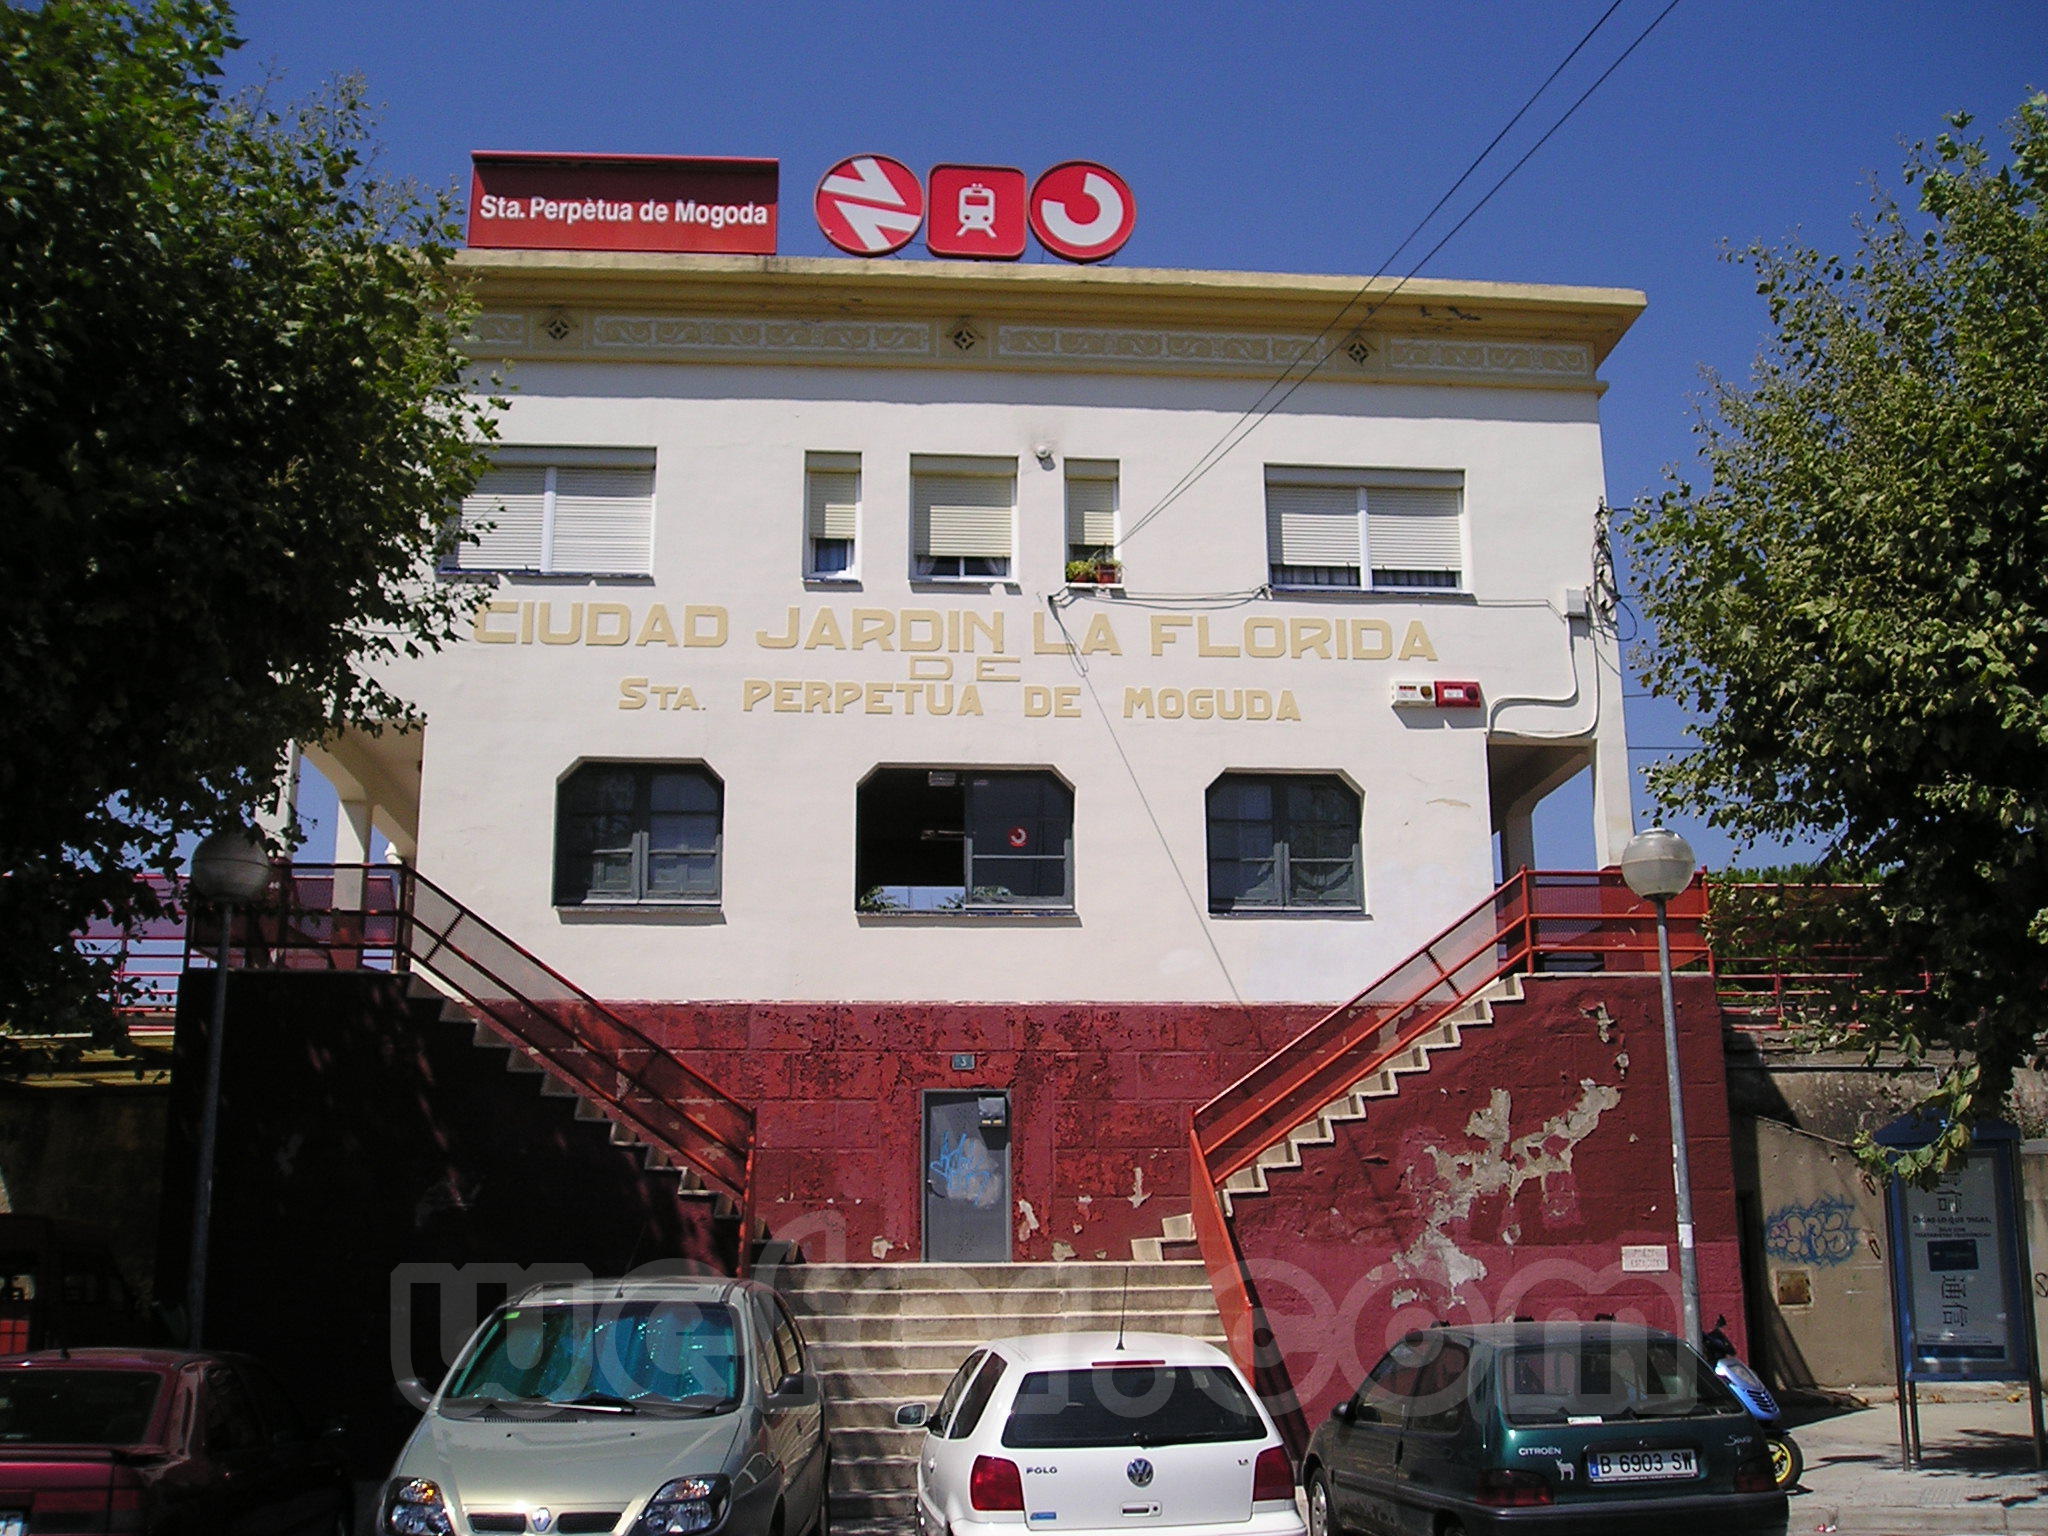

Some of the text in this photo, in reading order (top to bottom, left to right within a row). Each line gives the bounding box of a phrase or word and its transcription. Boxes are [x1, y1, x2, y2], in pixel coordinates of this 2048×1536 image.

[480, 194, 768, 229] Sta. Perpètua de Mogoda
[473, 601, 1438, 661] CIUDAD JARDIN LA FLORIDA
[910, 655, 1021, 682] DE
[743, 680, 983, 716] PERPETUA
[1024, 685, 1082, 719] DE
[1123, 686, 1301, 722] MOGUDA
[1026, 1466, 1058, 1475] POLO
[1600, 1455, 1612, 1474] B
[1620, 1453, 1664, 1473] 6903
